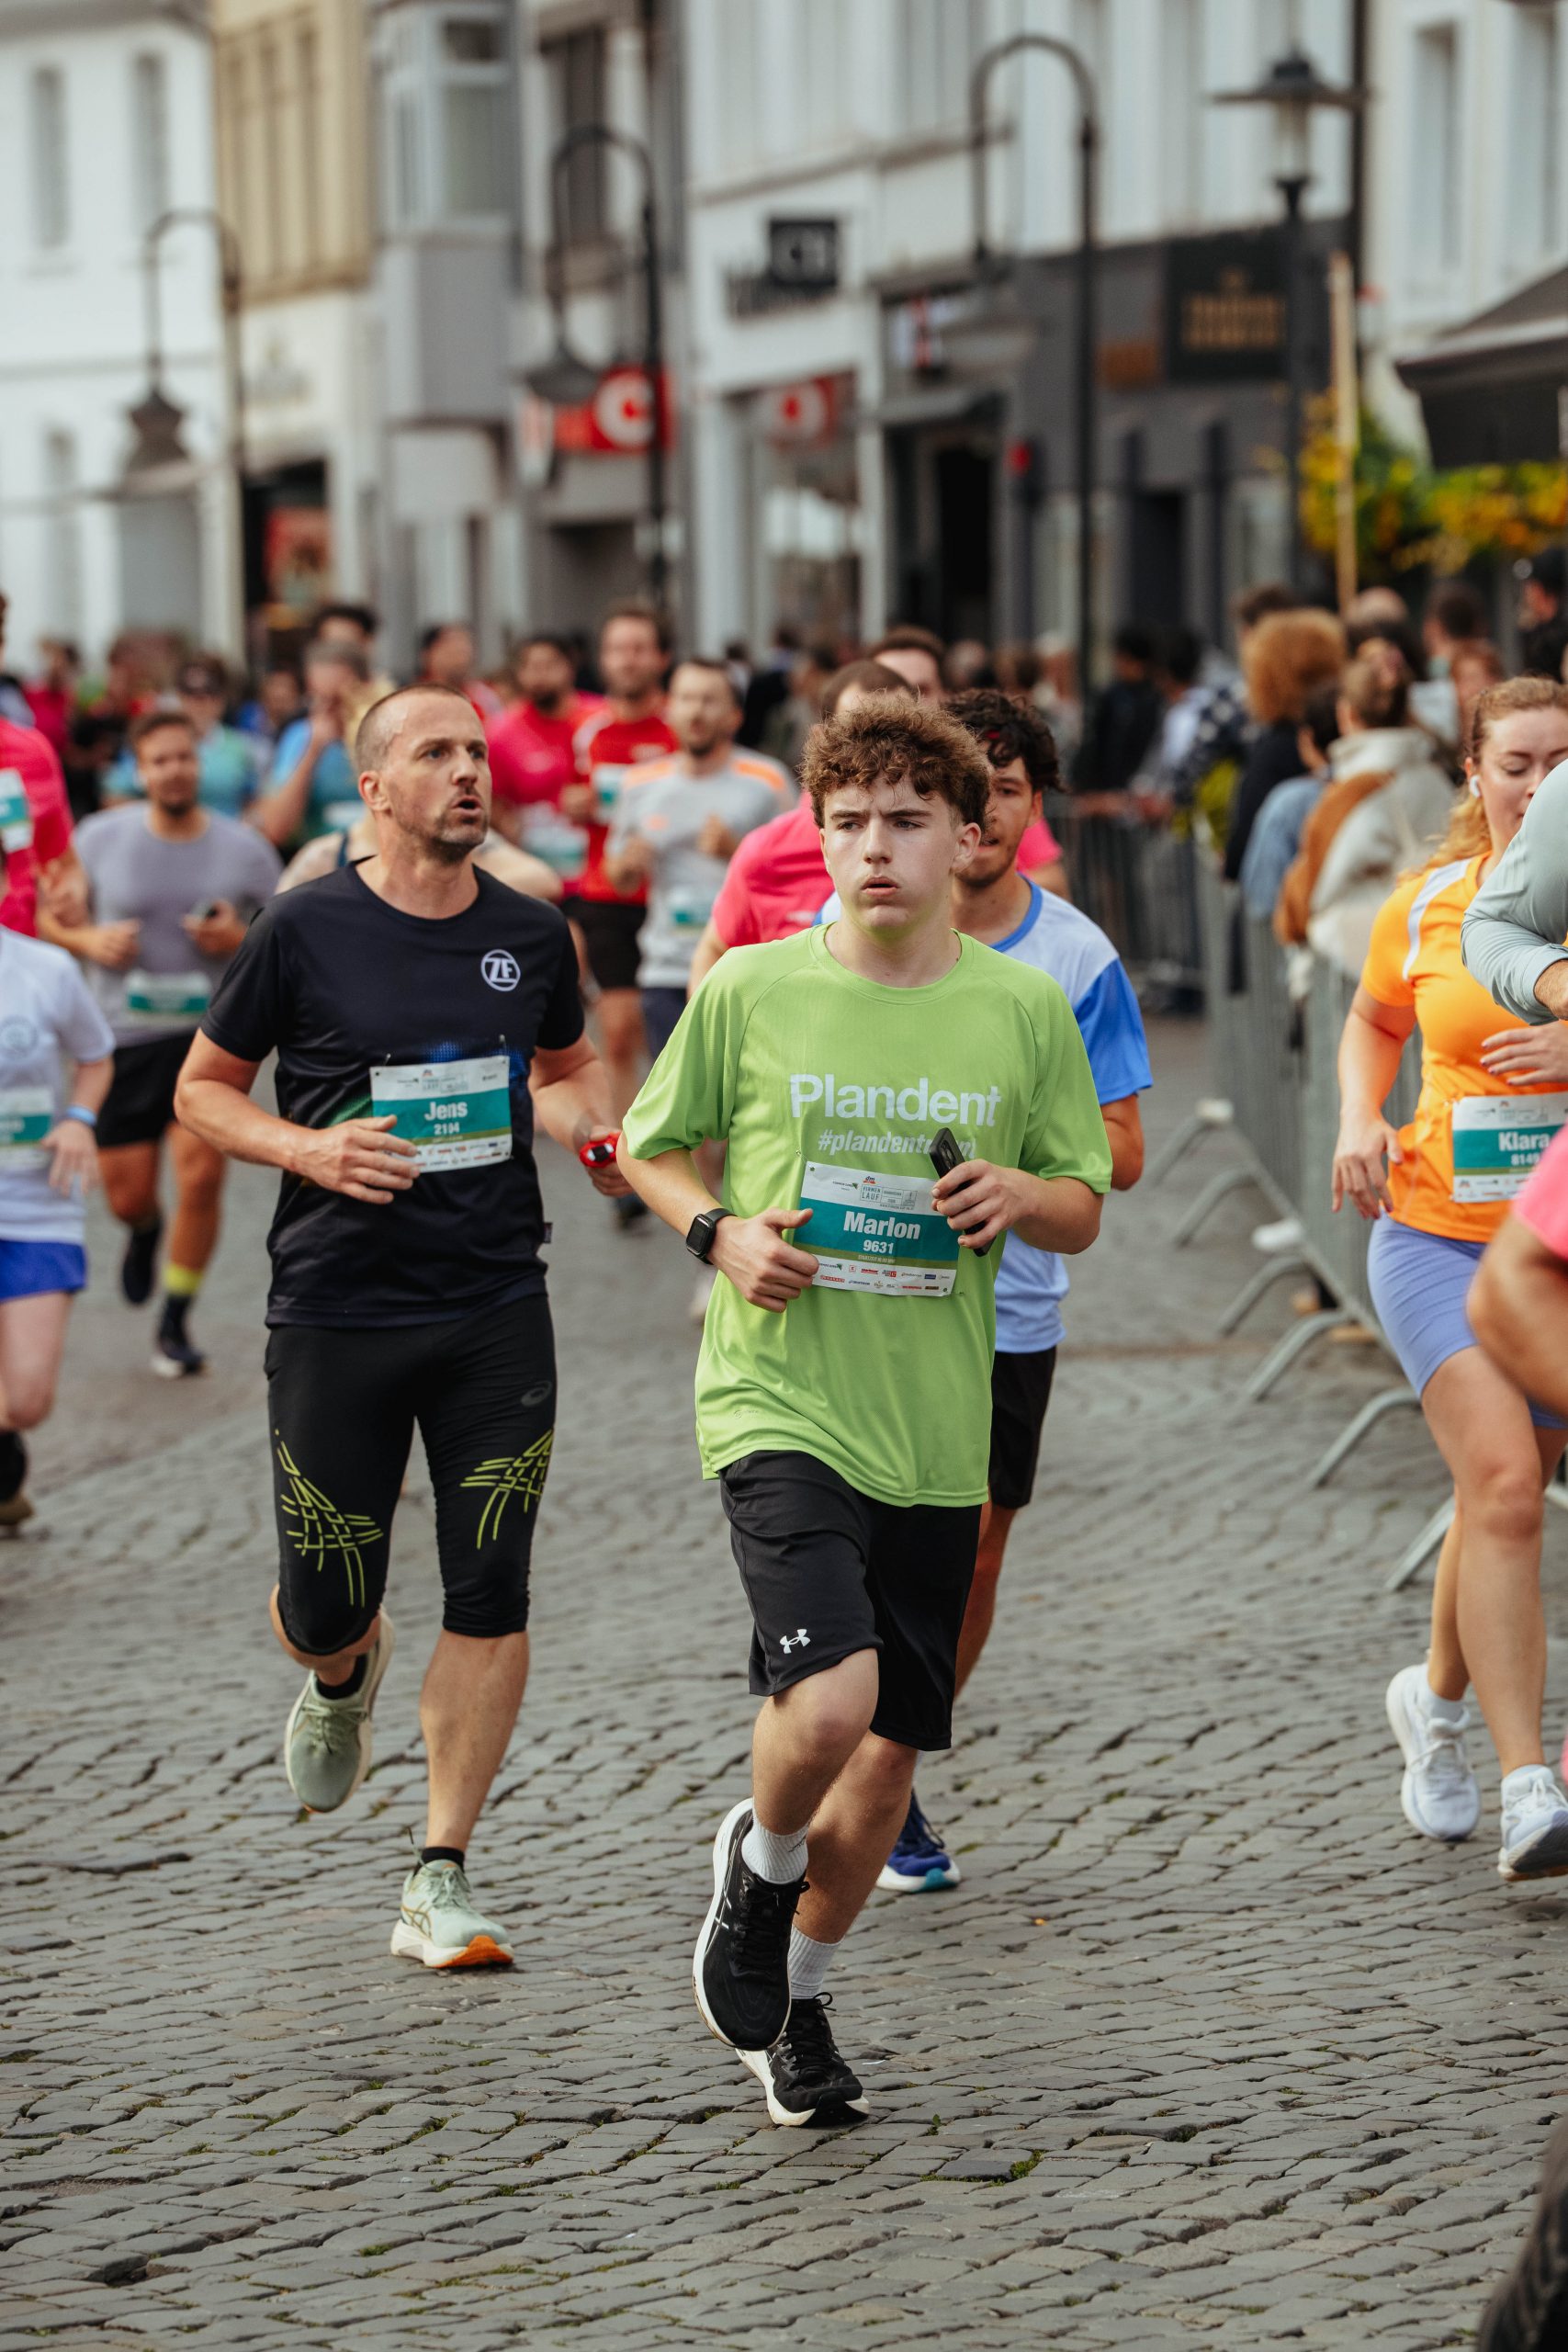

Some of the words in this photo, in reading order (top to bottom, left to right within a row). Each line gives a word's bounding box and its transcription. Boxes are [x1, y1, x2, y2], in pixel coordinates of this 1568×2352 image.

[483, 956, 518, 985] ZF
[789, 1073, 1001, 1126] Plandent
[423, 1102, 468, 1121] Jens
[1498, 1131, 1550, 1151] Klara
[862, 1193, 880, 1201] LAUF
[863, 1185, 881, 1193] FIRMEN
[843, 1211, 921, 1239] Marlon
[863, 1239, 894, 1254] 9631
